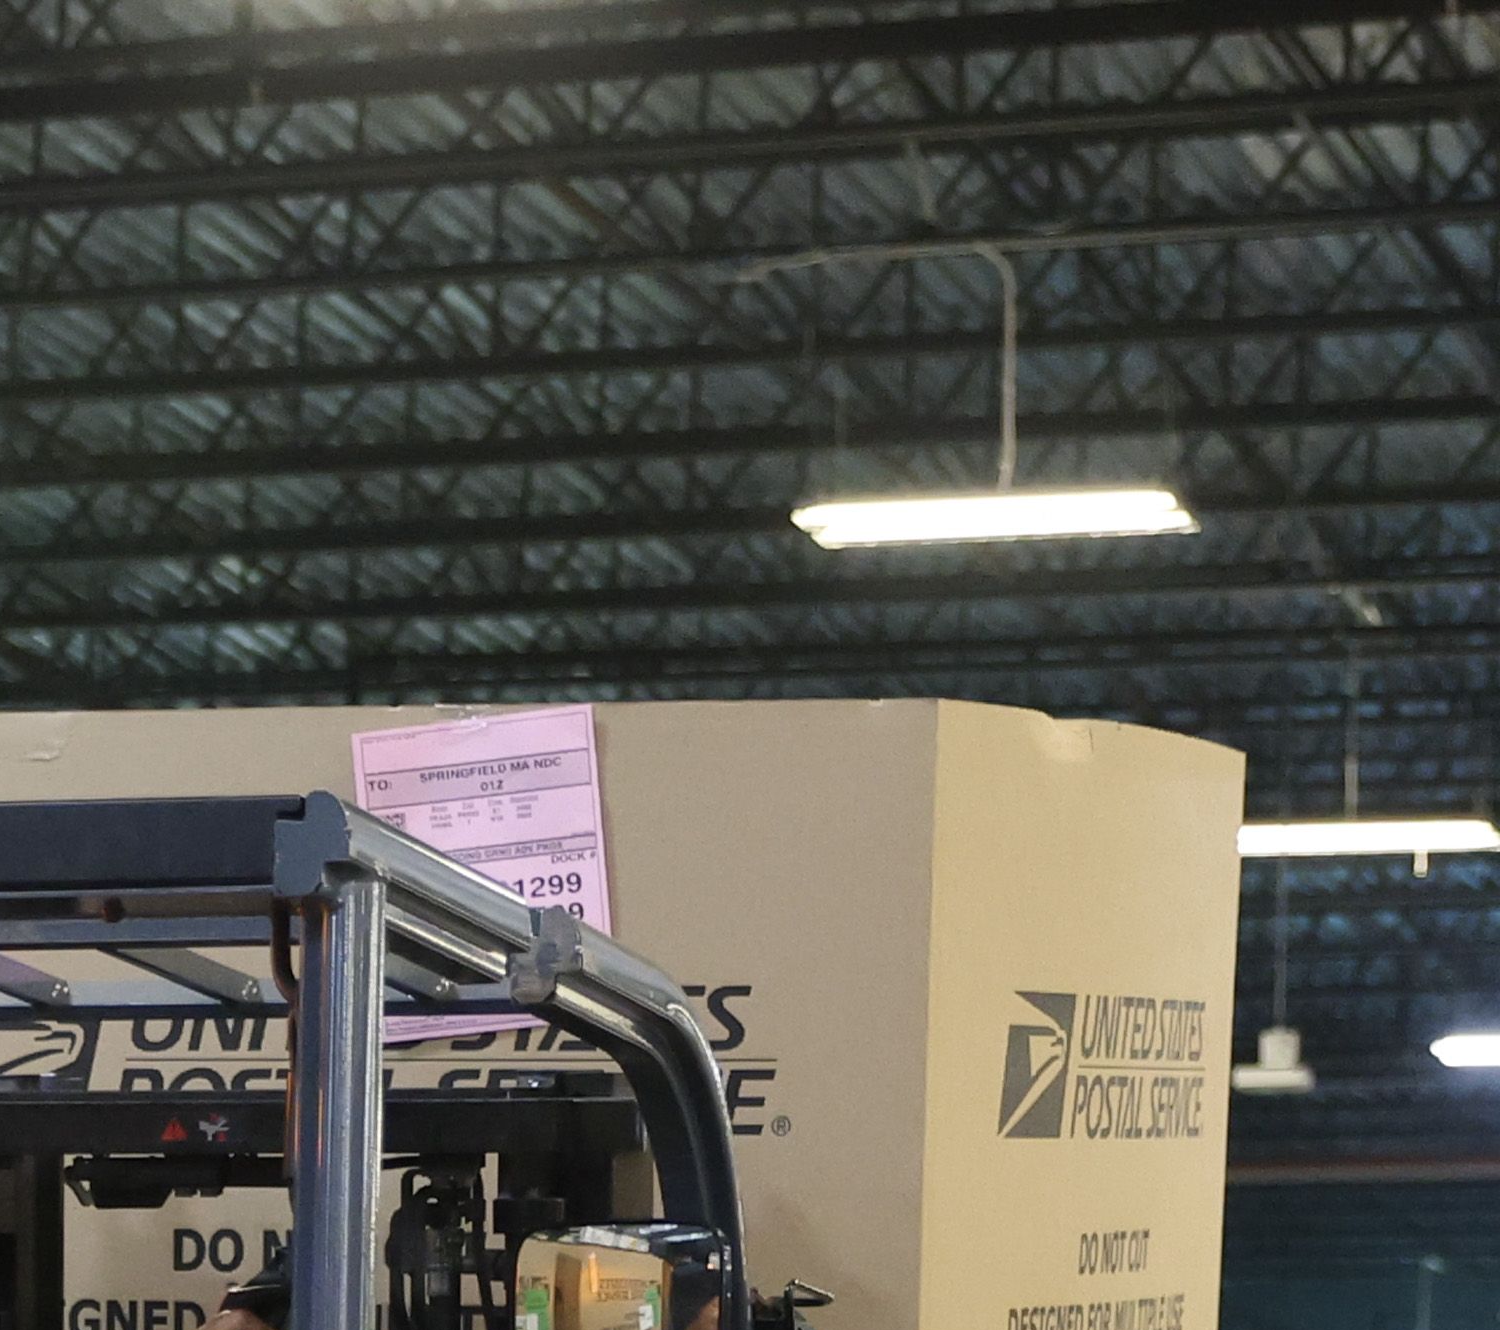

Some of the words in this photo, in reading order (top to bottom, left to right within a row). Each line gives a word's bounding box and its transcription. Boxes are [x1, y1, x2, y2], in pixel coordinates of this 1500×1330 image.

[419, 765, 506, 783] SPRINGFIELD
[510, 760, 529, 772] MA
[534, 757, 562, 769] NDC
[551, 853, 586, 864] DOCK
[1081, 994, 1156, 1060] UNITED
[1070, 1075, 1143, 1139] POSTAL
